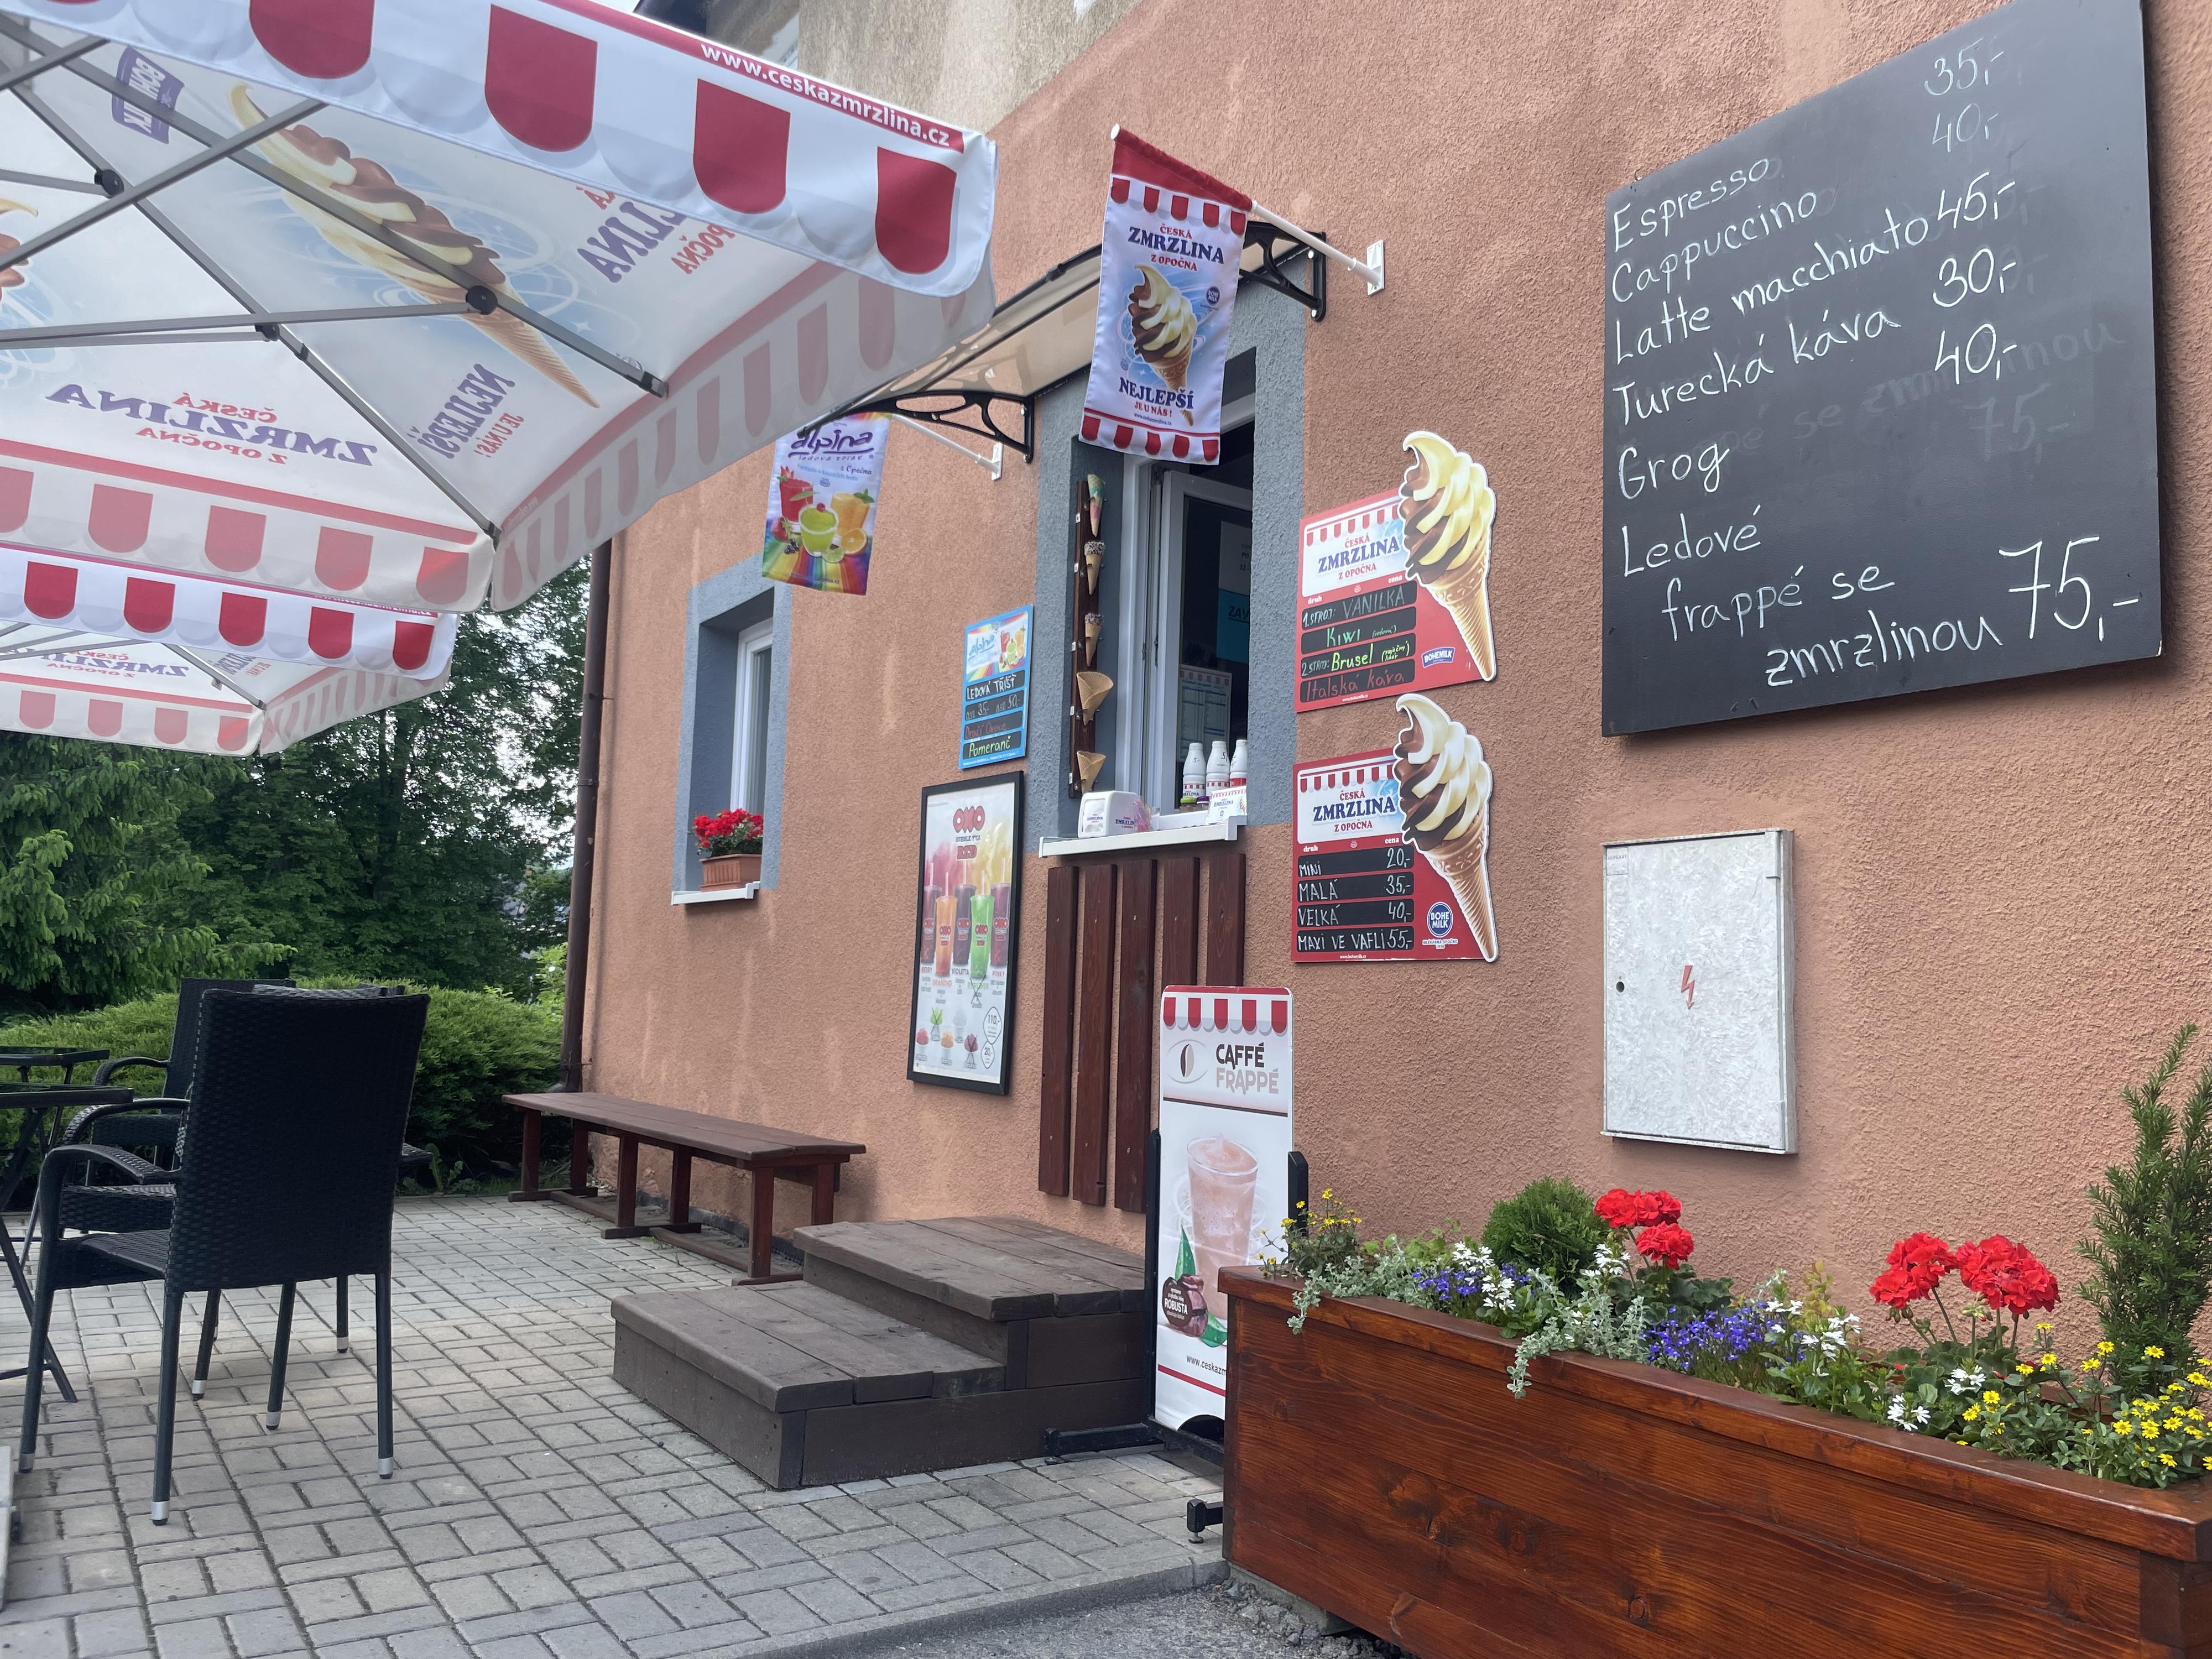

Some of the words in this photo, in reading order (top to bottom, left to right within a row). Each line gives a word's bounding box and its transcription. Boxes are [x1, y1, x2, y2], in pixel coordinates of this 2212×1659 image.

[701, 44, 951, 148] www.ceskazmrzlina.cz
[1614, 158, 1770, 252] Espresso
[1924, 37, 2005, 96] 35,-
[1612, 191, 1818, 303] Cappuccino
[1932, 103, 1999, 153] 40,-
[1160, 223, 1192, 240] ČESKÁ
[1128, 226, 1224, 265] ZMRZLINA
[1151, 254, 1157, 263] Z
[1159, 255, 1198, 272] OPOČNA
[1615, 298, 1710, 365] Latte
[1731, 208, 1929, 316] macchiato
[1937, 171, 2016, 232] 45,-
[1613, 333, 1773, 426] Turecká
[1790, 309, 1901, 366] káva
[1932, 248, 2017, 309] 30,-
[1119, 377, 1194, 410] NEJLEPŠÍ
[1134, 401, 1144, 411] JE
[1144, 403, 1151, 413] U
[1619, 443, 1731, 500] Grog
[1933, 324, 2018, 385] 40,-
[1344, 533, 1370, 549] ČESKÁ
[1621, 505, 1761, 578] Ledové
[1318, 536, 1400, 573] ZMRZLINA
[1339, 571, 1344, 580] Z
[1345, 562, 1377, 578] OPOČNA
[1388, 574, 1402, 583] cena
[1307, 595, 1322, 604] druh
[1342, 586, 1405, 620] VANILKA
[1661, 565, 1804, 642] frappé
[1831, 563, 1896, 599] se
[1766, 609, 2003, 687] zmrzlinou
[1997, 536, 2140, 641] 75,-
[1331, 643, 1374, 672] Brusel
[1424, 650, 1453, 664] BOHEMILK
[1306, 670, 1362, 702] Italská
[1367, 668, 1405, 690] káva
[969, 735, 1011, 758] Pomeranč
[1339, 788, 1365, 801] ČESKÁ
[1313, 796, 1396, 822] ZMRZLINA
[1334, 823, 1340, 832] Z
[1340, 818, 1373, 831] OPOČNA
[1303, 844, 1318, 853] druh
[1385, 837, 1400, 845] cena
[1386, 848, 1411, 868] 20,-
[1298, 878, 1339, 901] MALÁ
[1386, 875, 1411, 895] 35,-
[1297, 904, 1340, 927] VELKÁ
[1387, 901, 1412, 924] 40,-
[1431, 912, 1449, 921] BOHE
[1432, 920, 1448, 929] MILK
[1332, 933, 1346, 950] VE
[1387, 928, 1413, 950] 55,-
[988, 1014, 1000, 1026] 110,-
[1215, 1042, 1265, 1072] CAFFÉ
[1215, 1067, 1279, 1095] FRAPPÉ
[1164, 1298, 1188, 1315] ROBUSTA
